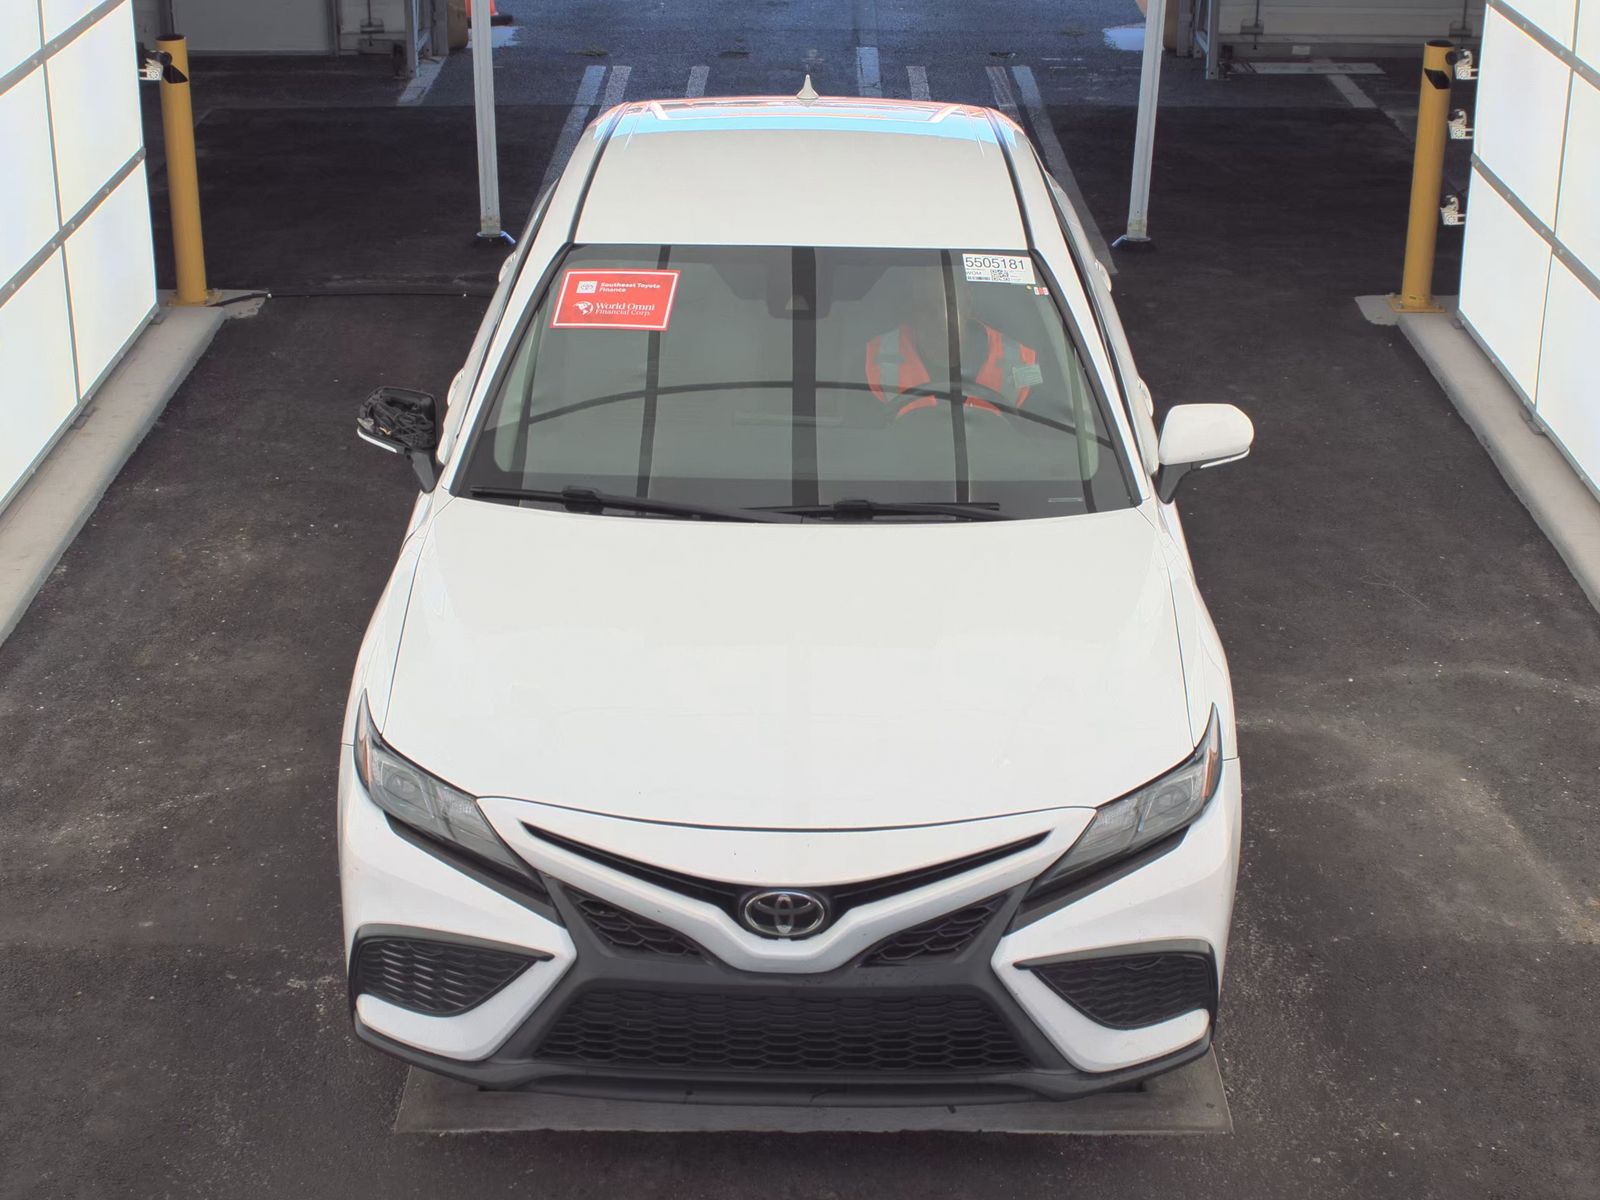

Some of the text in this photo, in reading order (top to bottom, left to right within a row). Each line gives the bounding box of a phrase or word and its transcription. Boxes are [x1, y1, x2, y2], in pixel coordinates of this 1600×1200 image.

[965, 257, 1025, 270] 5505181
[596, 302, 655, 311] World Omni
